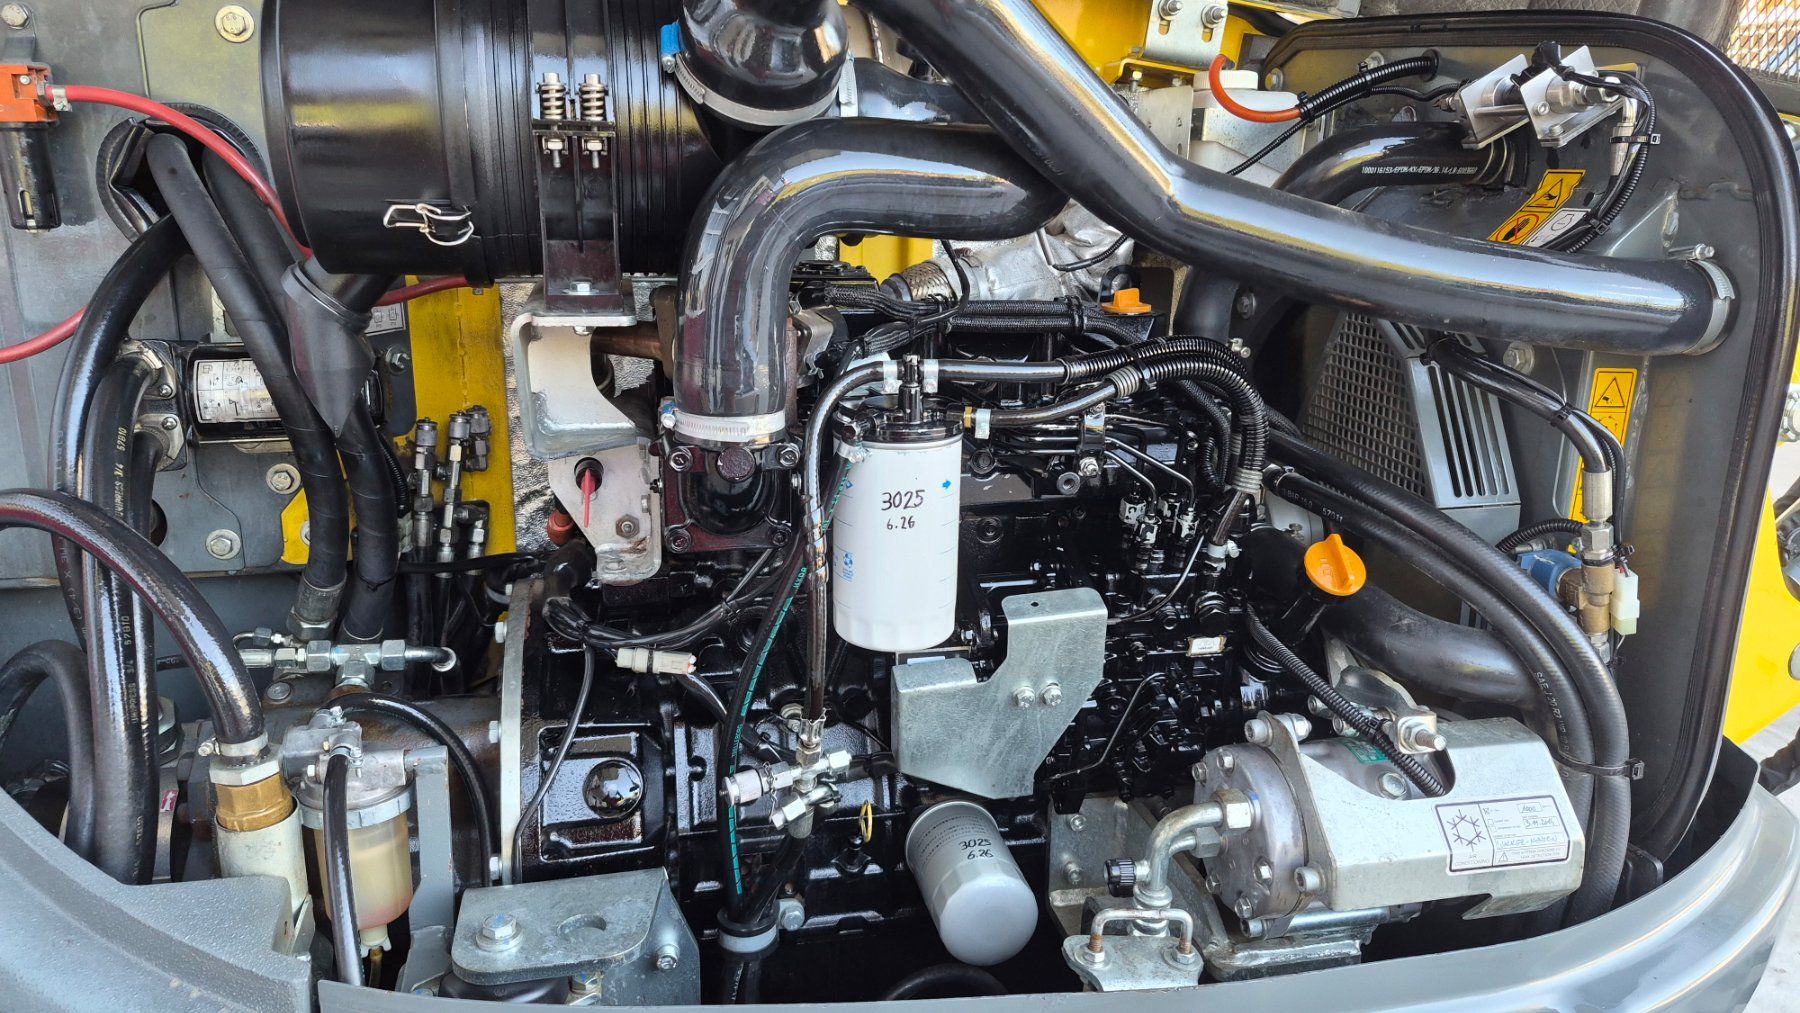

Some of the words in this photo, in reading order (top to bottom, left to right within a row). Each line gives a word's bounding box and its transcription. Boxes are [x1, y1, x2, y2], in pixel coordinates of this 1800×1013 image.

[881, 489, 926, 511] 3025
[886, 515, 916, 531] 6.26
[958, 838, 992, 851] 3025
[967, 848, 994, 860] 6.26
